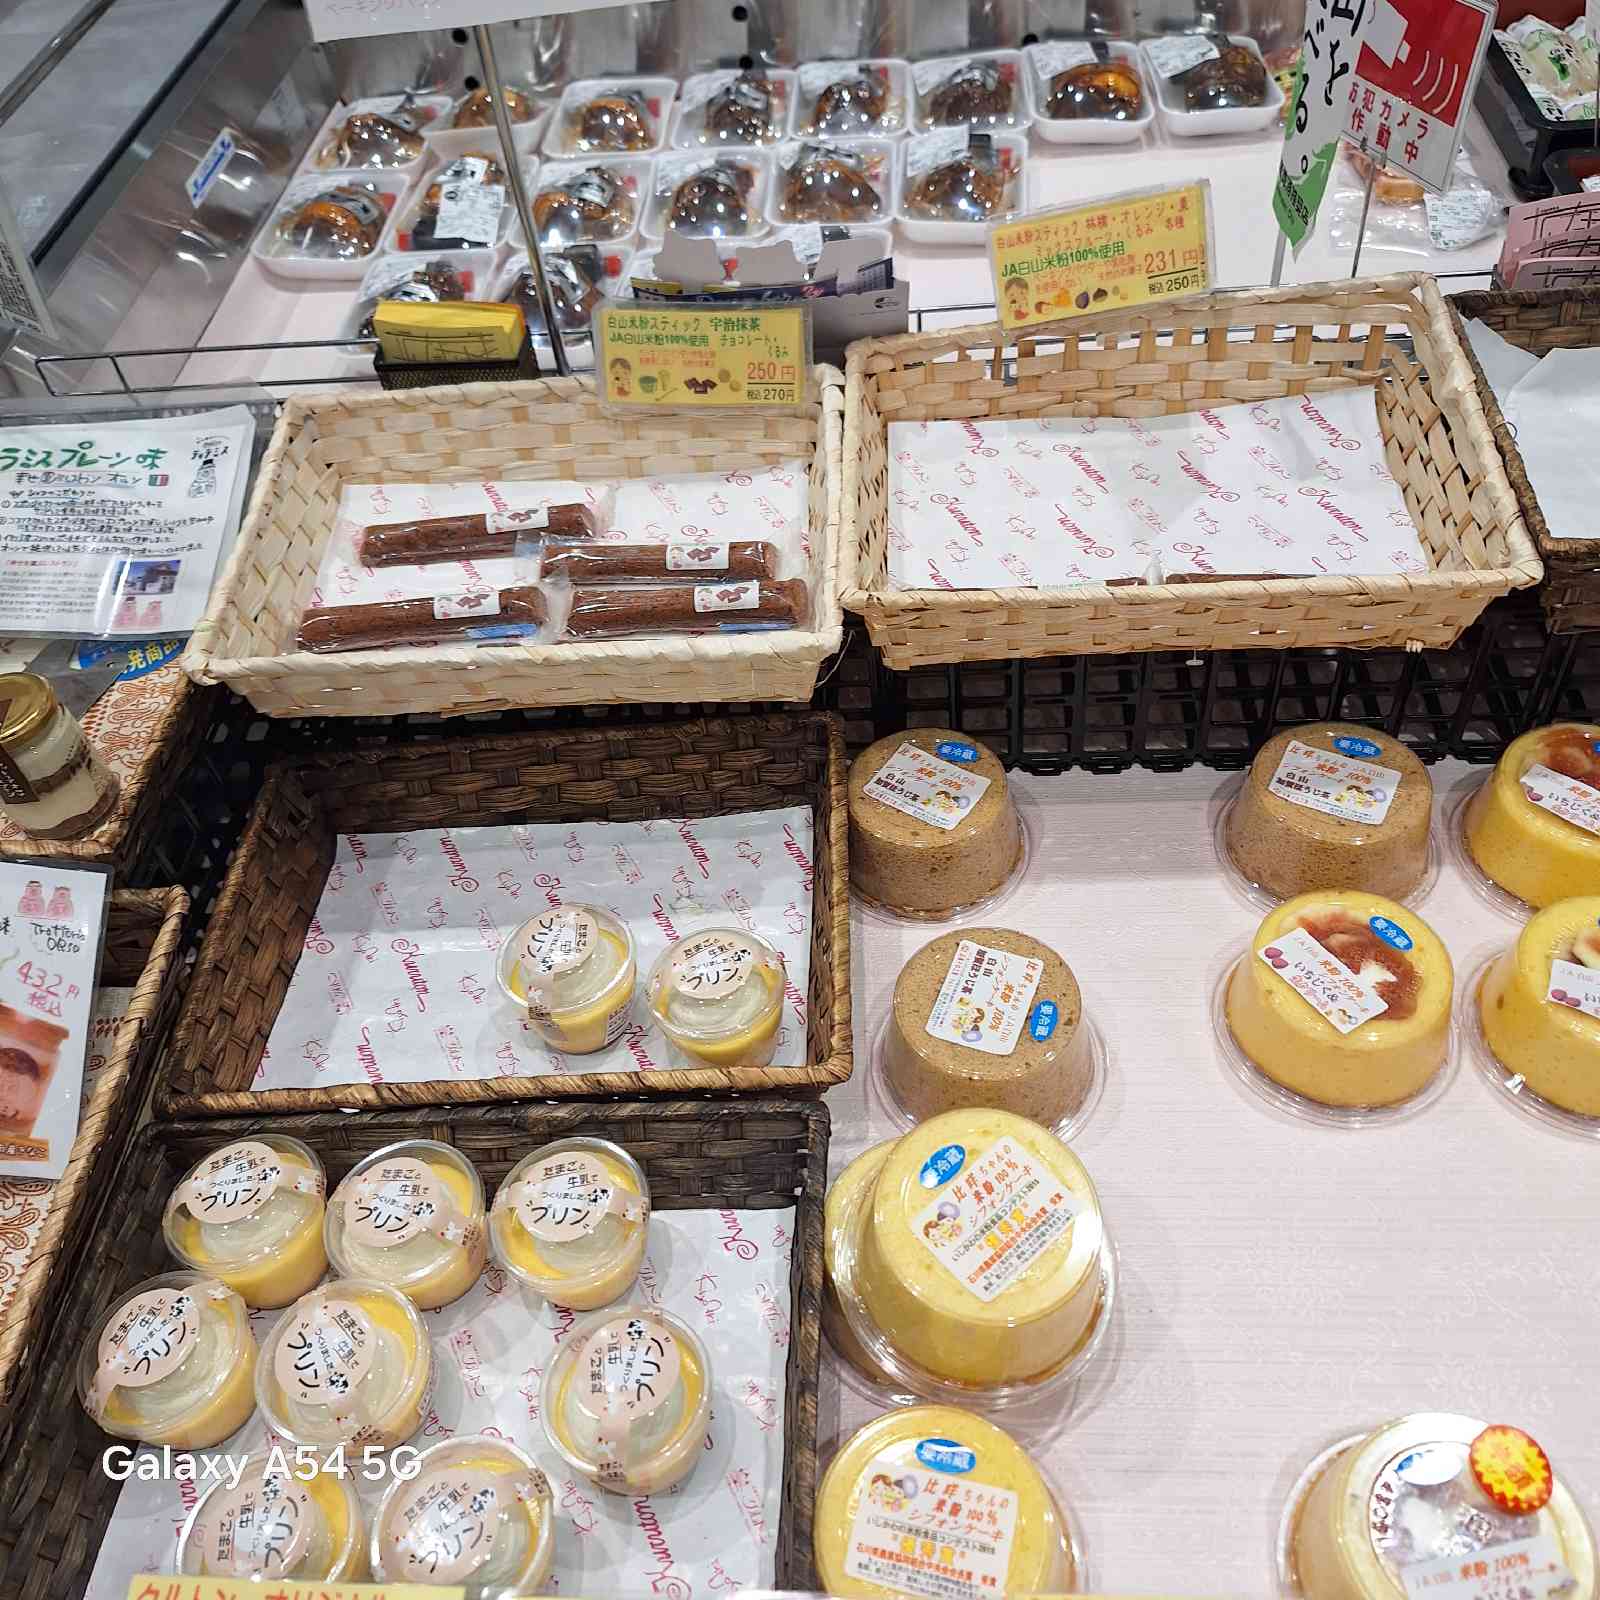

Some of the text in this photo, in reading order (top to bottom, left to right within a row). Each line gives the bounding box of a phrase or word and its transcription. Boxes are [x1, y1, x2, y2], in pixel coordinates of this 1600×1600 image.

[1351, 107, 1419, 164] 作動中
[1002, 240, 1126, 277] JA白山米粉100%使用
[1144, 248, 1198, 274] 231円
[527, 917, 554, 959] プリン
[686, 967, 740, 990] プリン
[201, 1186, 261, 1212] プリン
[531, 1206, 590, 1226] プリン
[354, 1206, 410, 1232] プリン
[132, 1322, 187, 1376] プリン
[287, 1331, 321, 1389] プリン
[636, 1336, 665, 1402] プリン
